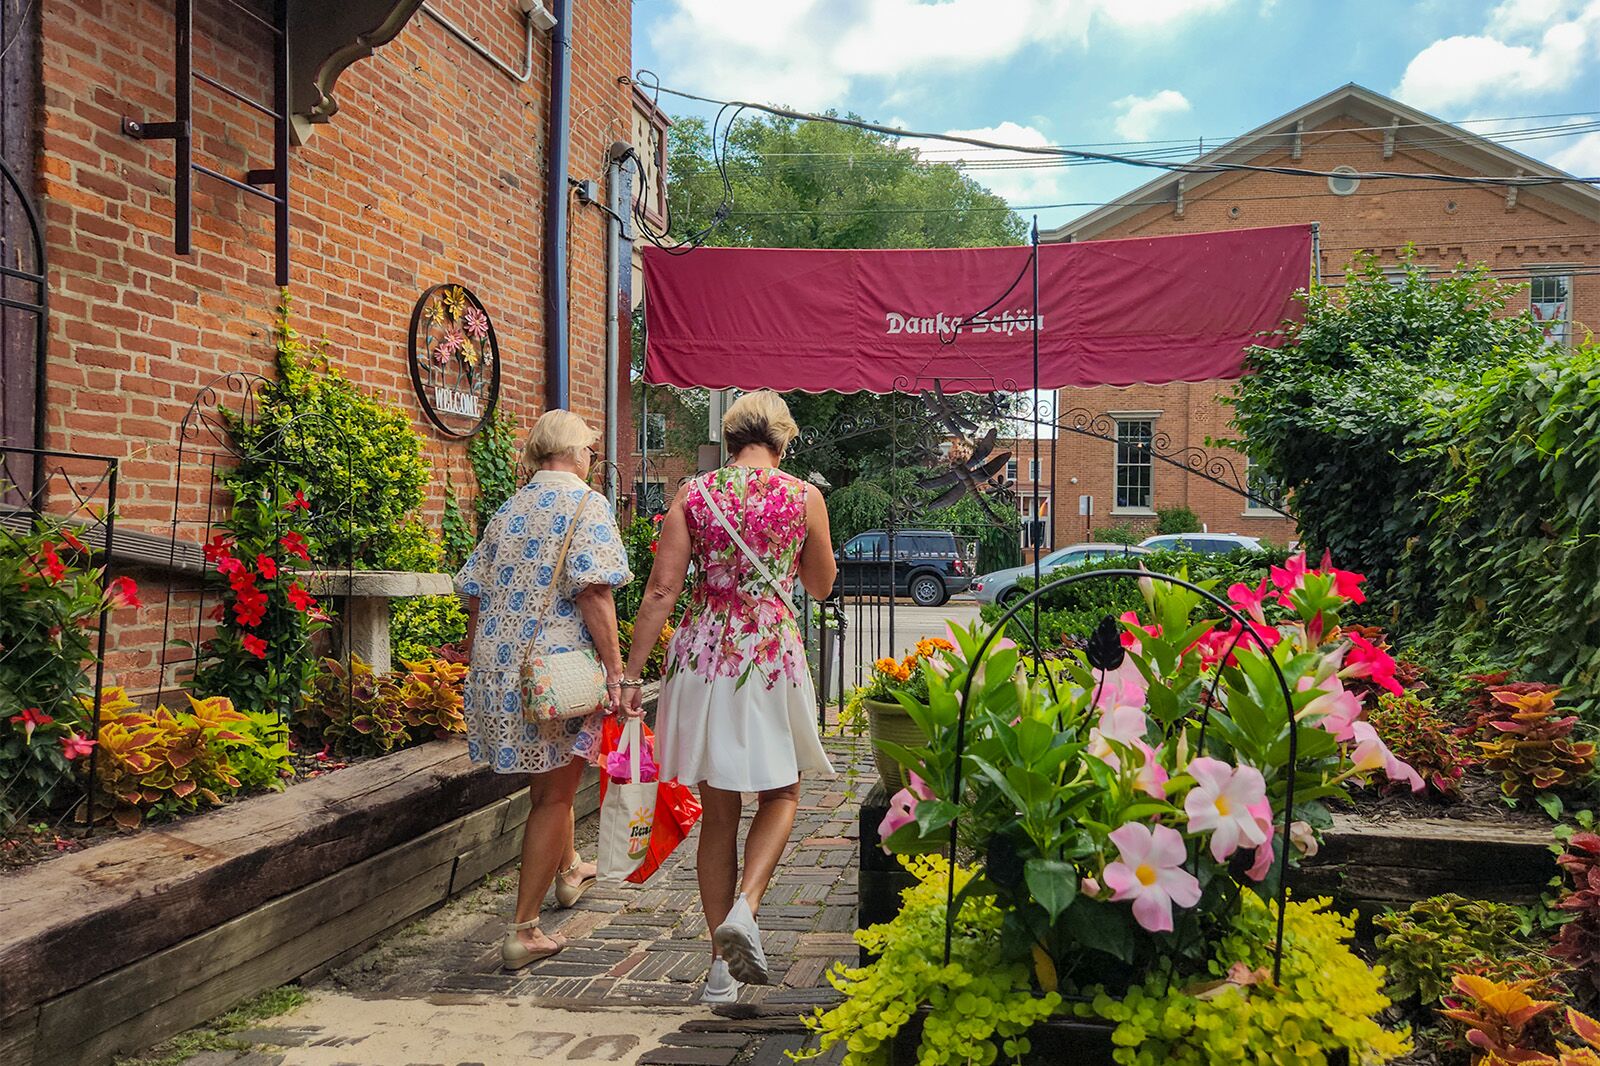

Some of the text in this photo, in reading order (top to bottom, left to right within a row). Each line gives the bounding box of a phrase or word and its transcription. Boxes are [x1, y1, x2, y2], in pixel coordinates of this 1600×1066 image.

[886, 309, 1044, 337] Danke Schön
[434, 386, 481, 418] WELCOME
